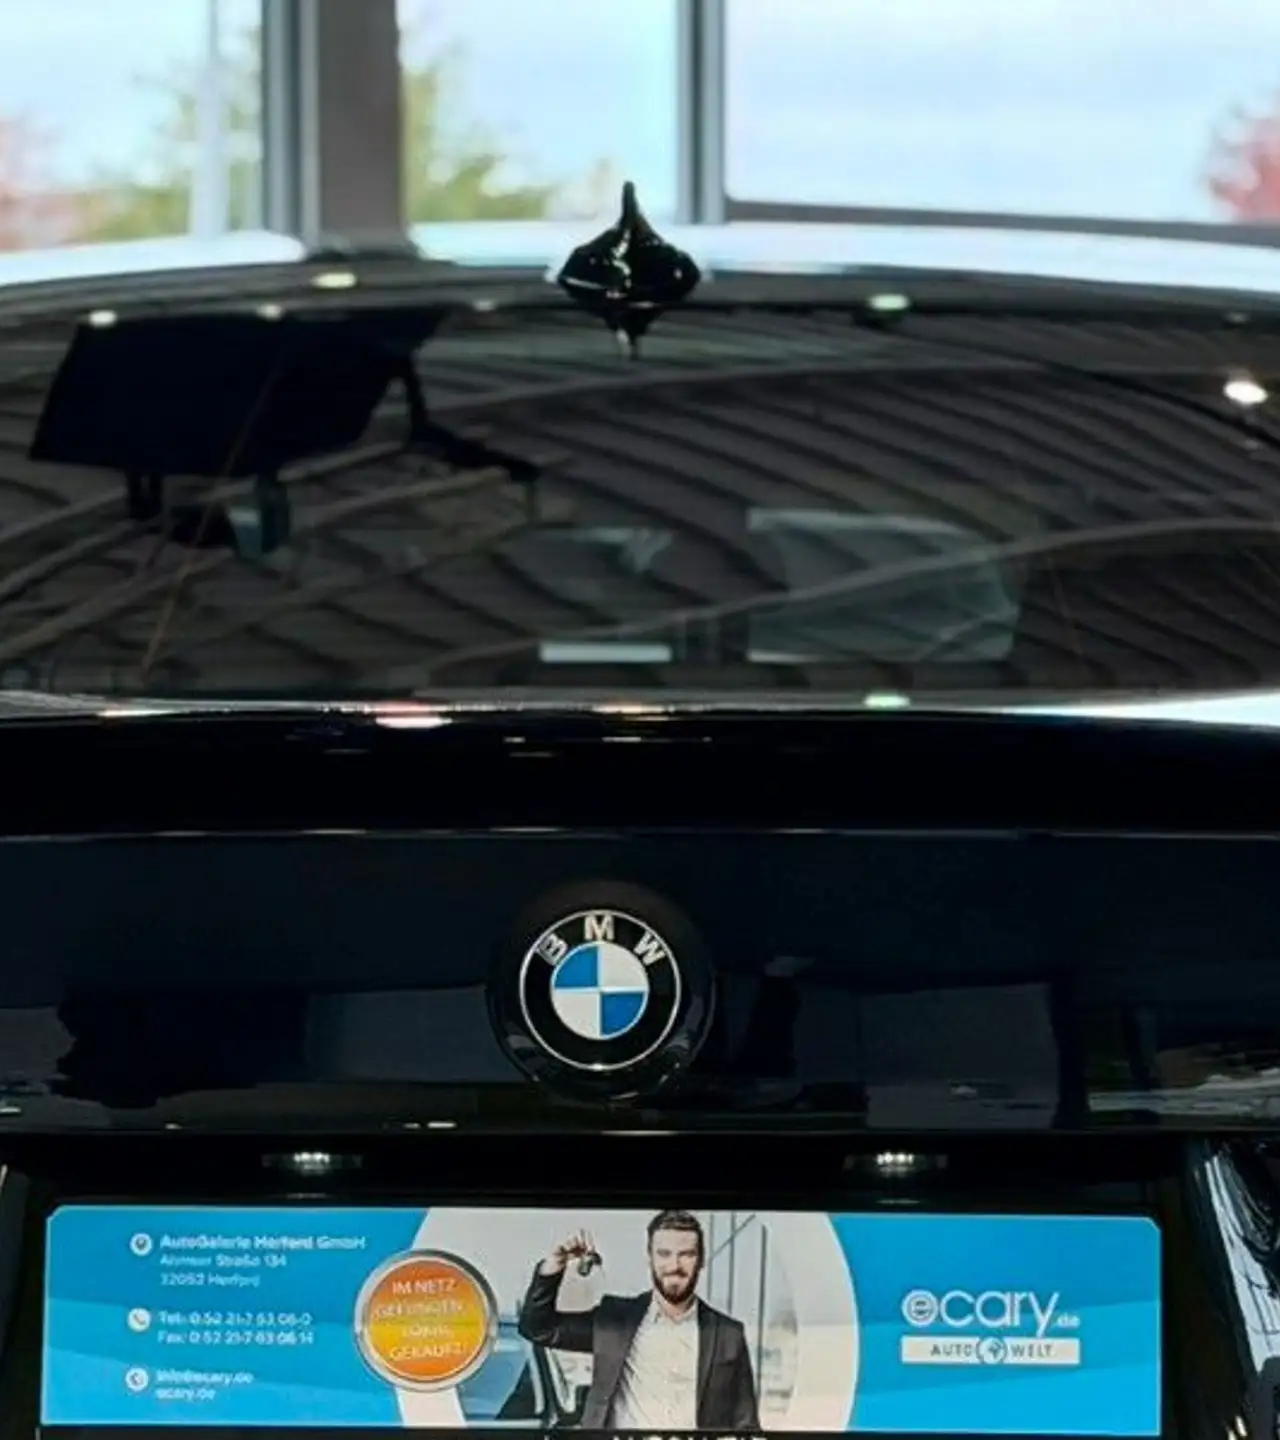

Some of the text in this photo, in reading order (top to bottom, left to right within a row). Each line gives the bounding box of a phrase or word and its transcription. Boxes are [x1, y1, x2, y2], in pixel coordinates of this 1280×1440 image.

[535, 913, 666, 966] BMW
[929, 1343, 1054, 1358] AUTO WELT
